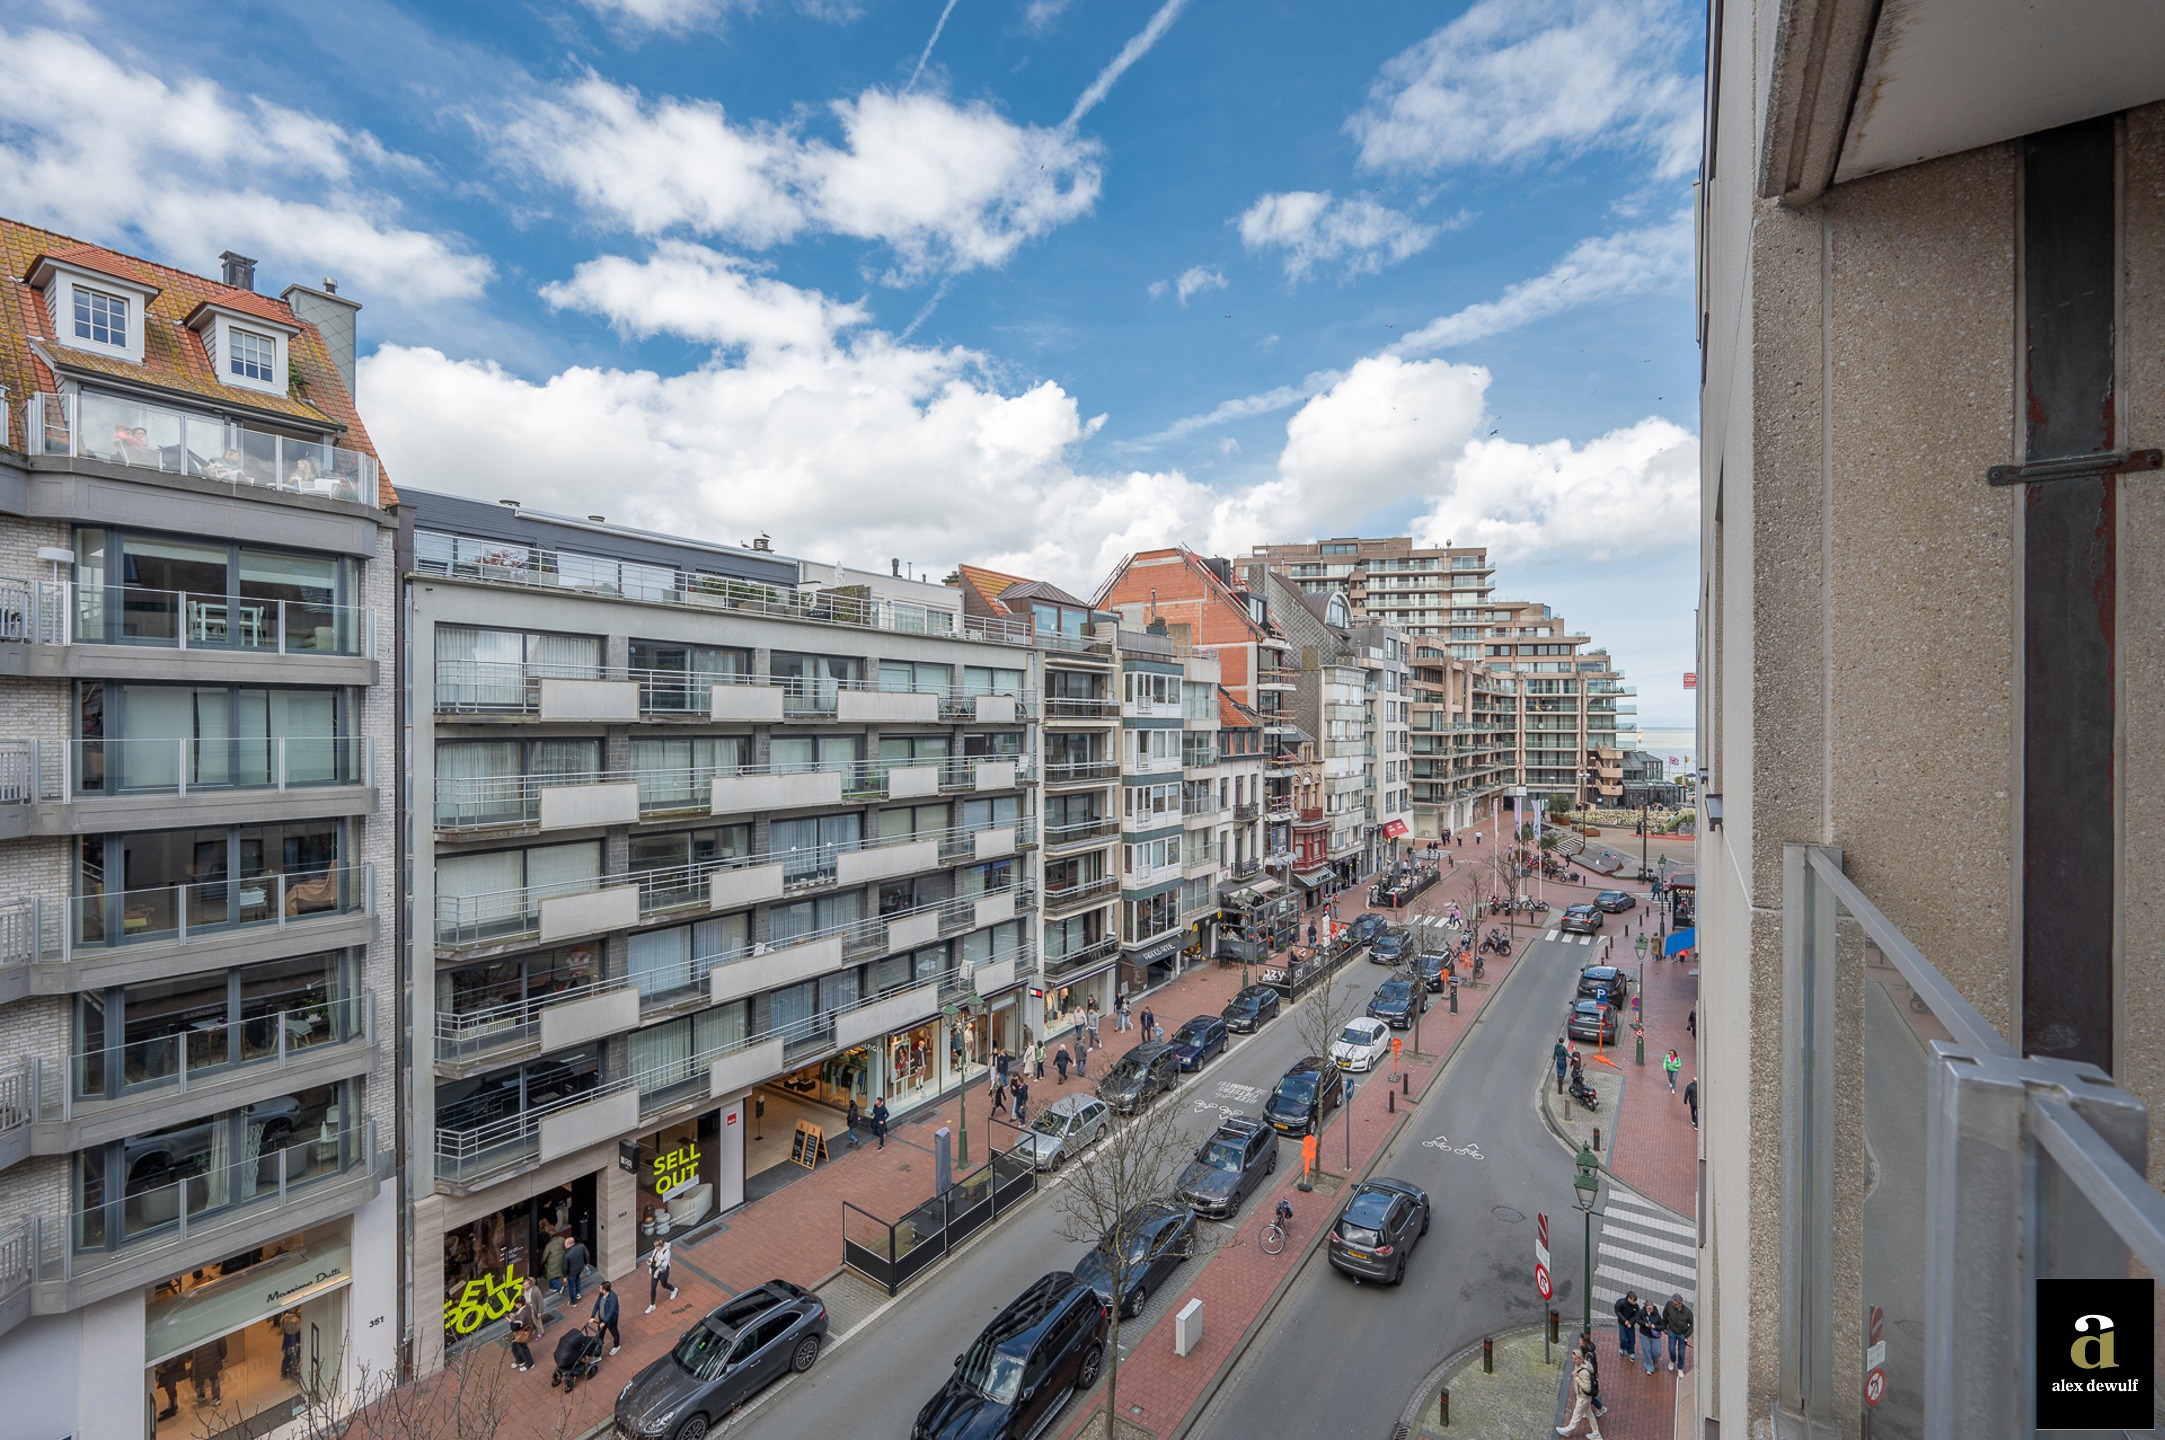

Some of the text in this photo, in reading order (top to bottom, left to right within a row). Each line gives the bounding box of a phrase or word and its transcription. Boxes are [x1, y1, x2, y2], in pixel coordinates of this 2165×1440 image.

[1597, 988, 1606, 999] P
[653, 1143, 701, 1177] SELL
[655, 1161, 699, 1195] OUT
[266, 1267, 342, 1304] Massimo Dutti
[369, 1315, 385, 1329] 351
